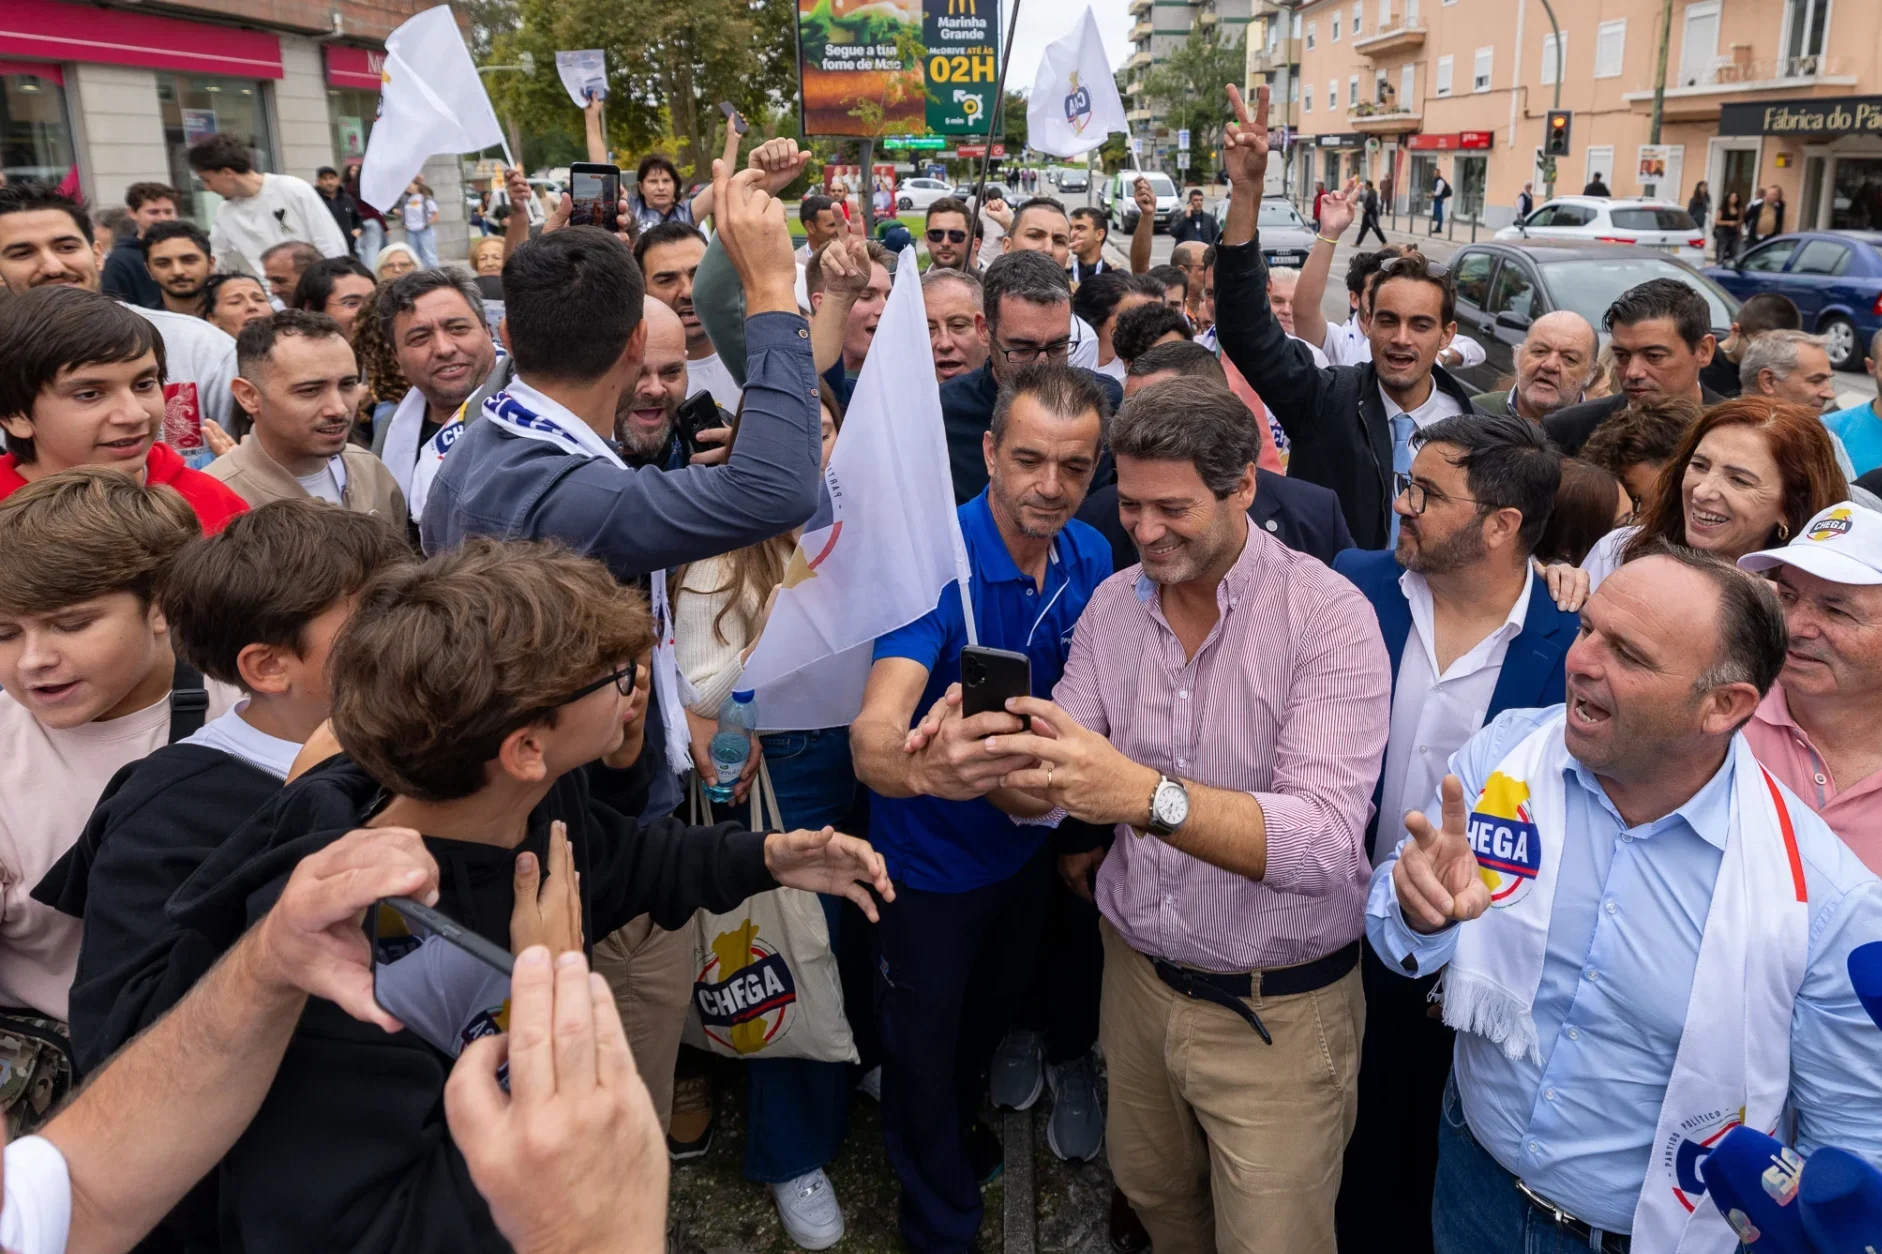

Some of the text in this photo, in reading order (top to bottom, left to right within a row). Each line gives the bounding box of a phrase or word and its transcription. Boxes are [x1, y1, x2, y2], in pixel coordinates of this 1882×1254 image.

[937, 16, 987, 28] Marinha
[941, 28, 985, 40] Grande
[825, 44, 898, 59] Segue a tua
[929, 47, 966, 55] McDRIVE
[822, 58, 902, 70] fome de Mac
[929, 55, 995, 83] 02H
[945, 117, 965, 125] 5 min
[1763, 107, 1824, 131] Fábrica
[1826, 105, 1852, 130] do
[1813, 520, 1847, 531] CHEGA
[698, 965, 785, 1016] CHEGA
[1665, 1132, 1681, 1168] PARTIDO
[1681, 1110, 1721, 1131] POLÍTICO
